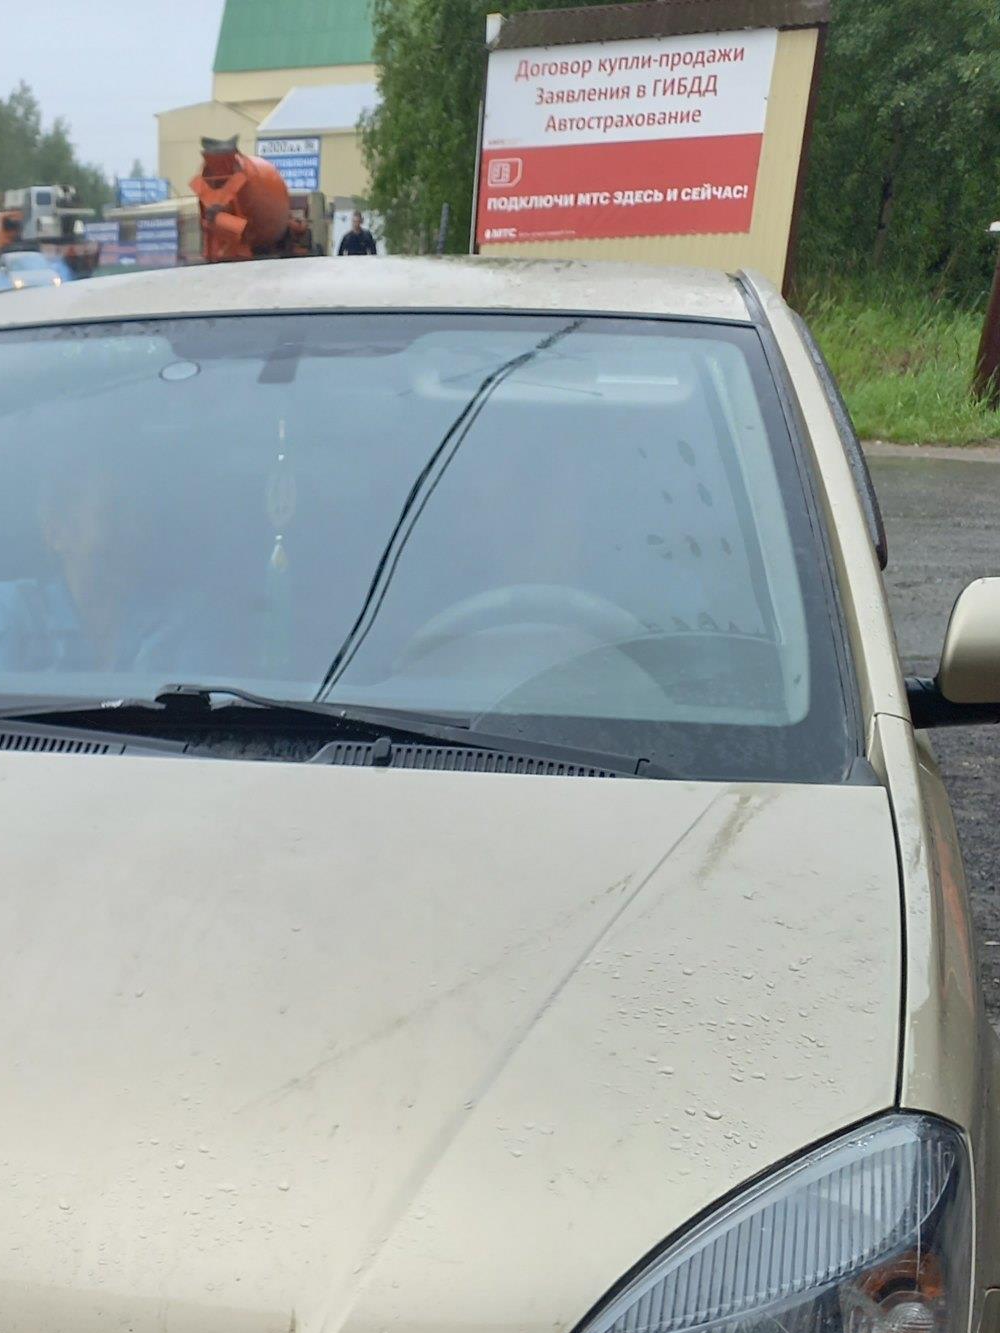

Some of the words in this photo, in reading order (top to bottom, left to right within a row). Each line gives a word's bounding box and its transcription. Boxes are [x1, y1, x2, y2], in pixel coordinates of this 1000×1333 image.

[515, 60, 592, 81] Договор
[598, 47, 745, 76] купли-продажи
[535, 85, 631, 105] Заявления
[636, 84, 646, 98] в
[652, 74, 719, 98] ГИБДД
[545, 108, 702, 133] Автострахование
[487, 194, 576, 212] ПОДКЛЮЧИ
[577, 191, 611, 206] МТС
[613, 189, 665, 207] ЗДЕСЬ
[666, 187, 678, 202] И
[681, 183, 749, 201] СЕЙЧАС!
